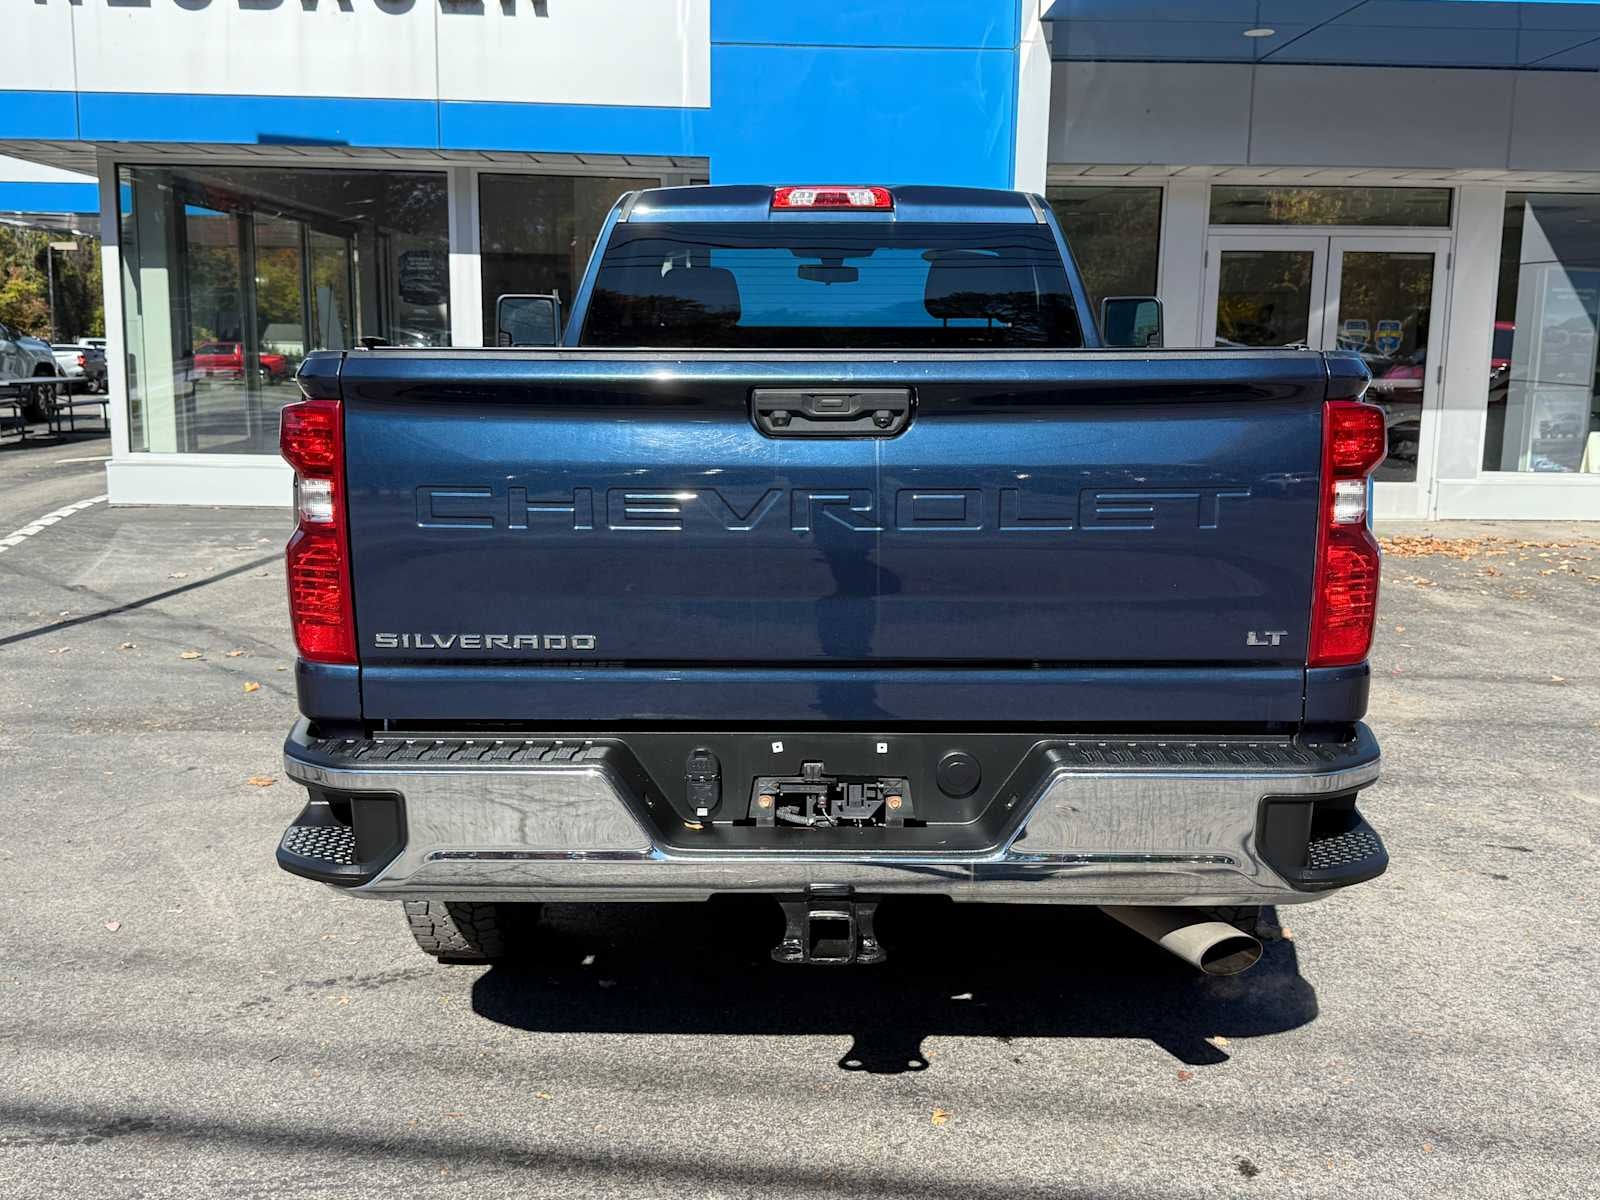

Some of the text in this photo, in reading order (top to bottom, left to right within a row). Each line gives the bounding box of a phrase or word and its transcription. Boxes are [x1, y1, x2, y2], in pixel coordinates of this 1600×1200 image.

[415, 485, 1252, 532] CHEVROLET
[374, 632, 597, 650] SILVERADO
[1246, 630, 1289, 646] LT
